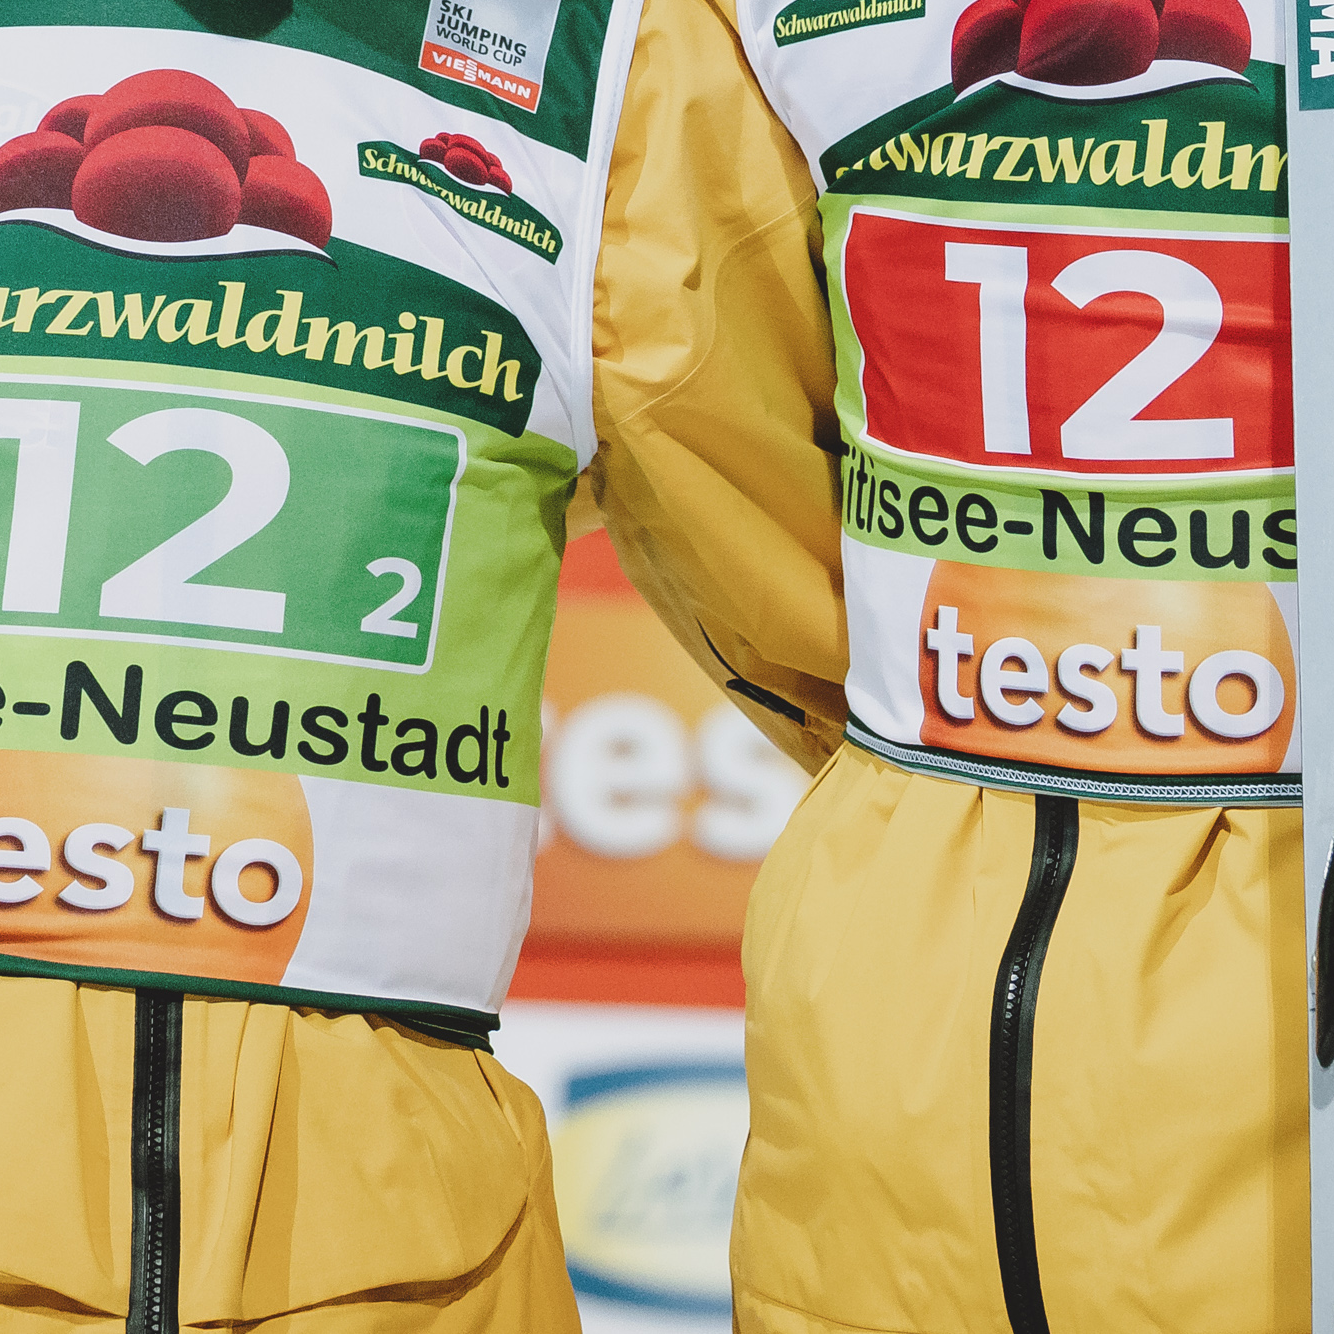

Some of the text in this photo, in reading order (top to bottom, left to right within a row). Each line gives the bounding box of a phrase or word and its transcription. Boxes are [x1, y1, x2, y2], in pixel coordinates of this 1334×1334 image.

[437, 13, 527, 58] JUMPING
[440, 0, 473, 22] SKI
[432, 51, 531, 100] VIESSMANN
[436, 25, 523, 67] WORLD CUP
[944, 241, 1235, 461] 12
[842, 442, 1298, 569] itisee-Neus
[360, 556, 423, 639] 2
[925, 605, 1285, 739] testo
